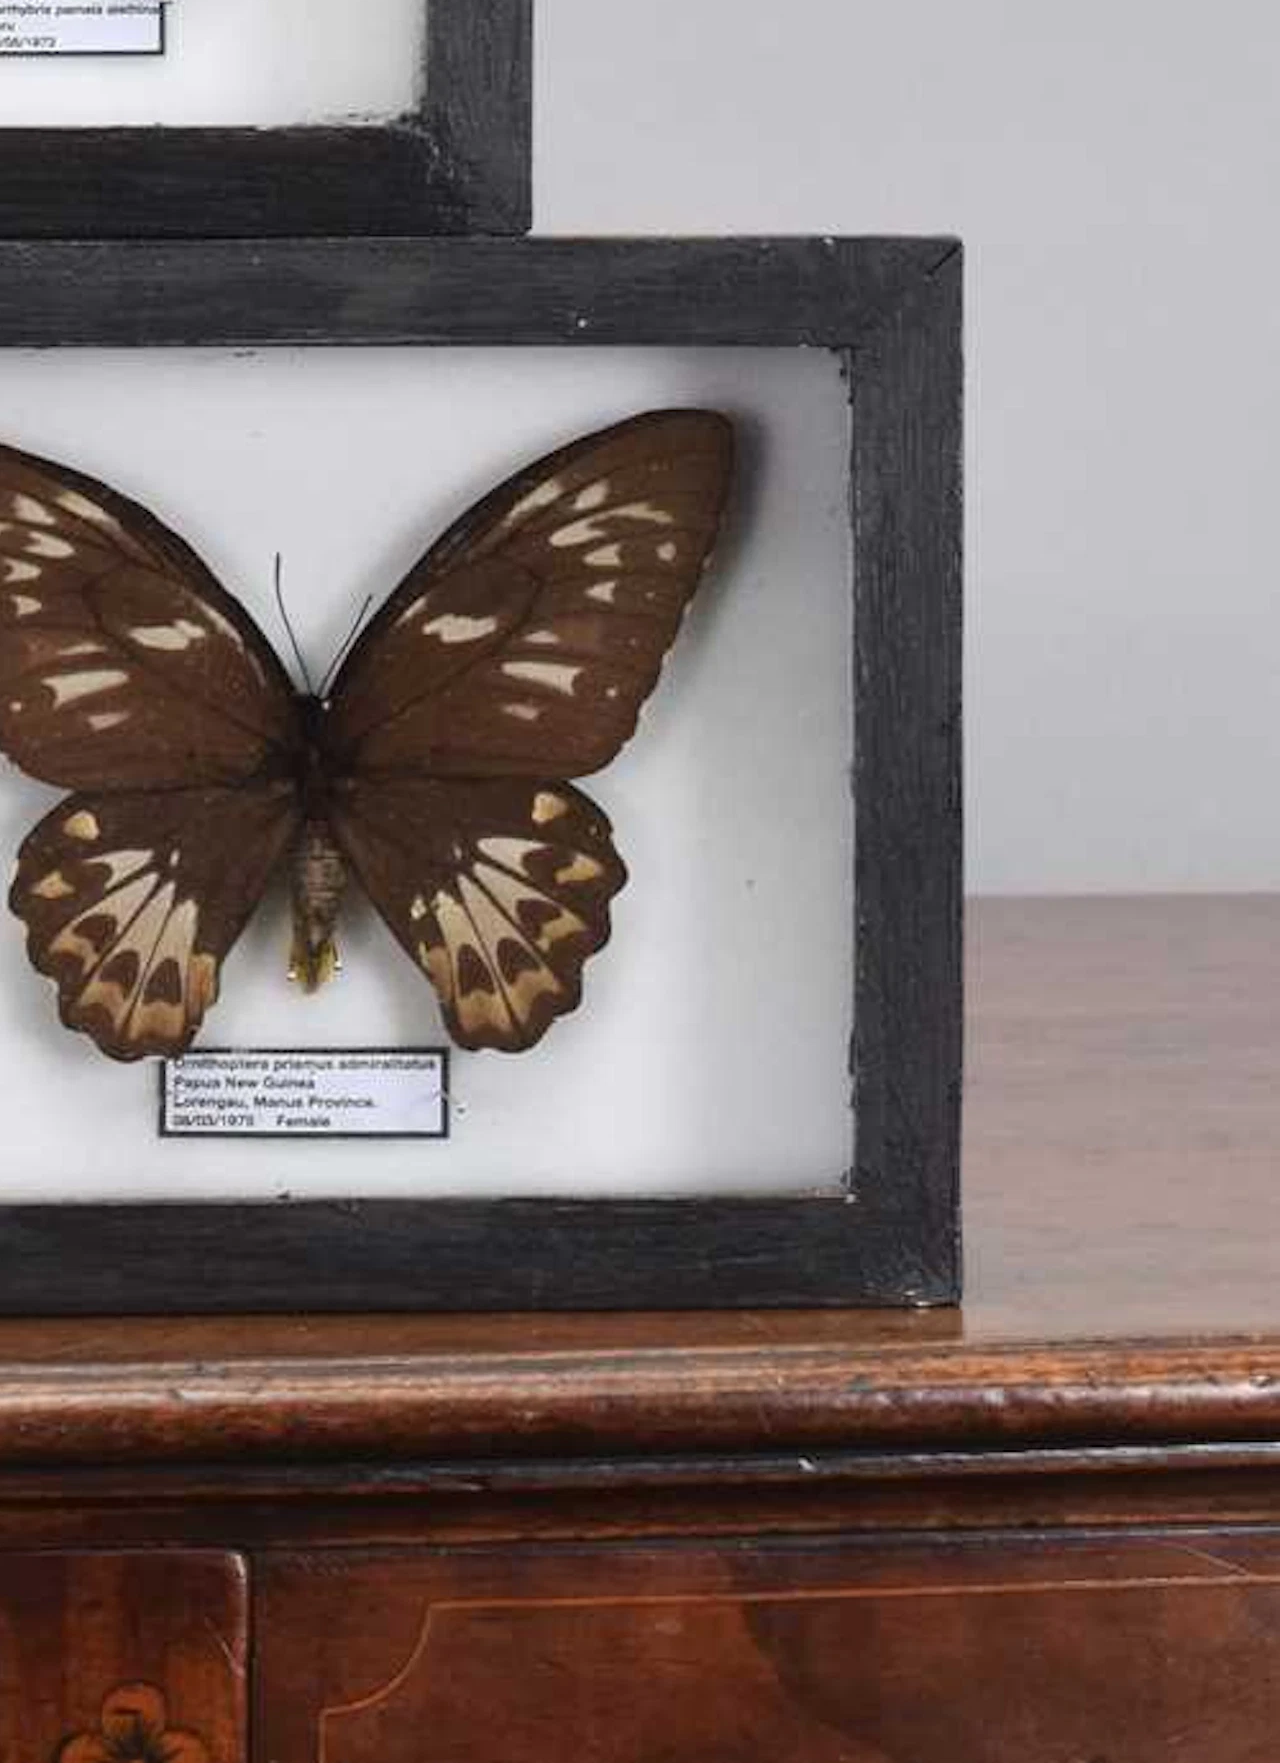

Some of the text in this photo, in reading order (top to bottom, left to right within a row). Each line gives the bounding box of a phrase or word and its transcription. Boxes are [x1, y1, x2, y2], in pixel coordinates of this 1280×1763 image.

[273, 1056, 332, 1073] priamus
[174, 1076, 315, 1092] Papua New Guinea
[254, 1095, 303, 1108] Manus
[276, 1114, 331, 1128] Female
